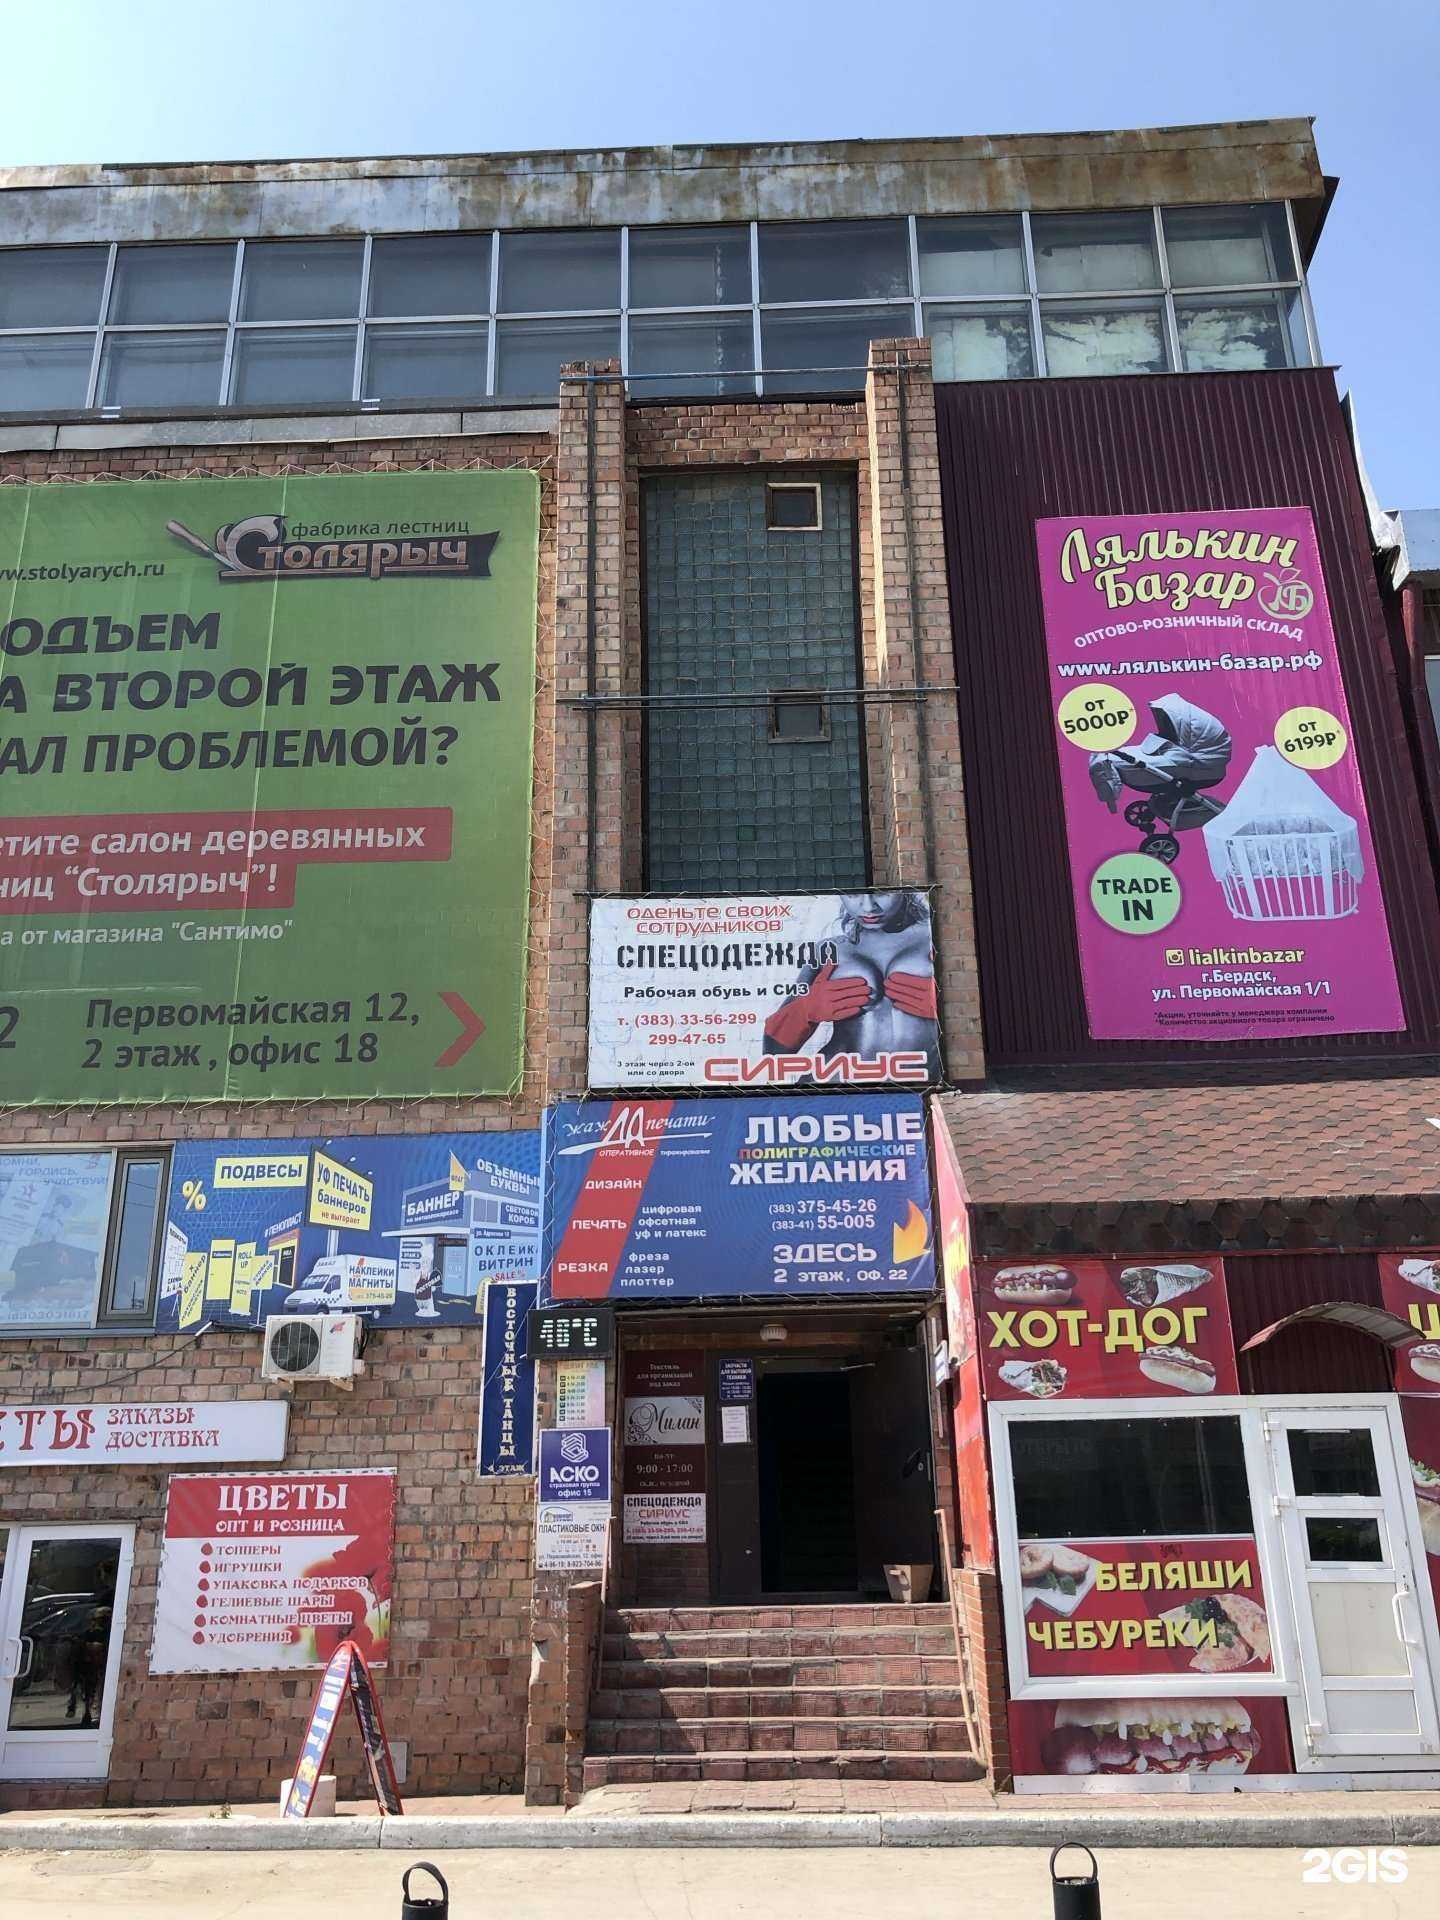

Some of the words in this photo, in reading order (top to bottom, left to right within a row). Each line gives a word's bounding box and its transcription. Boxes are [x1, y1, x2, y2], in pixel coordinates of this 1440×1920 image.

[291, 521, 380, 541] фабрика
[387, 520, 470, 538] лестниц
[215, 515, 468, 578] Столярыч
[1060, 528, 1298, 584] Лялькин
[1094, 566, 1255, 610] Базар
[1, 613, 220, 657] ОДЪЕМ
[1074, 614, 1243, 648] ОПТОВО-РОЗНИЧНЫЙ
[1246, 618, 1304, 642] СКЛАД
[1057, 650, 1323, 678] www.лялькин-базар.рф
[0, 675, 27, 713] А
[53, 663, 307, 713] ВТОРОЙ
[330, 662, 500, 705] ЭТАЖ
[0, 735, 67, 775] АЛ
[83, 716, 459, 773] ПРОБЛЕМОЙ?
[91, 831, 191, 854] салон
[201, 825, 425, 855] деревянных
[1097, 877, 1173, 895] TRADE
[627, 907, 720, 919] оденьте
[726, 905, 792, 917] своих
[1122, 899, 1155, 921] IN
[1, 931, 13, 945] а
[21, 929, 48, 945] от
[53, 926, 163, 944] магазина
[172, 919, 292, 943] "Сантимо"
[636, 920, 783, 937] сотрудников
[617, 941, 838, 971] СПЕЦОДЕЖДА
[1189, 947, 1304, 965] lialkinbazar
[1202, 969, 1277, 984] г.Бердск,
[624, 985, 696, 999] Рабочая
[702, 985, 751, 999] обувь
[757, 987, 767, 996] и
[773, 983, 809, 996] СИЗ
[1152, 989, 1176, 1001] ул.
[1180, 984, 1301, 1000] Первомайская
[1305, 982, 1331, 997] 1/1
[86, 996, 350, 1035] Первомайская
[364, 992, 420, 1025] 12,
[617, 1017, 629, 1026] т.
[634, 1013, 675, 1027] (383)
[680, 1013, 757, 1026] 33-56-299
[0, 1007, 20, 1049] 2
[649, 1034, 726, 1045] 299-47-65
[82, 1039, 100, 1069] 2
[229, 1034, 320, 1072] офис
[334, 1034, 378, 1062] 18
[704, 1053, 928, 1083] СИРИУС
[744, 1113, 922, 1144] ЛЮБЫЕ
[599, 1149, 654, 1157] ОПЕРАТИВНОЕ
[738, 1144, 916, 1160] ПОЛИГРАФИЧЕСКИЕ
[220, 1163, 302, 1181] ПОДВЕСЫ
[476, 1158, 540, 1187] ОБЪЕМНЫ
[730, 1159, 906, 1185] ЖЕЛАНИЯ
[317, 1162, 331, 1185] УФ
[333, 1172, 370, 1202] ПЕЧАТЬ
[490, 1176, 530, 1195] БУКВЫ
[585, 1177, 642, 1190] ДИЗАЙН
[182, 1181, 206, 1211] %
[318, 1189, 367, 1214] баннеров
[407, 1191, 460, 1216] БАННЕР
[642, 1204, 702, 1215] цифровая
[769, 1204, 795, 1214] (383)
[797, 1199, 877, 1213] 375-45-26
[321, 1211, 329, 1219] не
[331, 1213, 361, 1225] выгорает
[508, 1214, 535, 1225] КОРОБ
[572, 1218, 627, 1230] ПЕЧАТЬ
[638, 1216, 696, 1228] офсетная
[772, 1220, 814, 1231] (383-41)
[818, 1215, 876, 1229] 55-005
[635, 1229, 651, 1240] уф
[654, 1230, 662, 1238] и
[665, 1228, 707, 1238] латекс
[475, 1244, 539, 1256] ОКЛЕЙК
[628, 1251, 670, 1263] фреза
[773, 1243, 877, 1264] ЗДЕСЬ
[240, 1261, 249, 1269] UP
[479, 1257, 533, 1271] ВИТРИН
[558, 1262, 608, 1274] РЕЗКА
[625, 1263, 665, 1275] лазер
[349, 1277, 393, 1289] МАГНИТЫ
[495, 1271, 515, 1281] SALE
[620, 1276, 674, 1287] плоттер
[774, 1269, 787, 1283] 2
[888, 1269, 908, 1280] 22
[986, 1307, 1208, 1353] ХОТ-ДОГ
[501, 1287, 518, 1392] ВОСТОЧНЫЕ
[106, 1407, 196, 1425] ЗАКАЗЫ
[0, 1409, 95, 1450] ТЫ
[500, 1399, 516, 1456] ТАНЦЫ
[105, 1430, 219, 1452] ДОСТАВКА
[499, 1464, 525, 1473] ЭТАЖ
[550, 1465, 599, 1482] АСКО
[636, 1464, 658, 1473] 9:00
[667, 1463, 694, 1473] 17:00
[217, 1483, 348, 1516] ЦВЕТЫ
[558, 1489, 581, 1498] офис
[584, 1488, 592, 1496] 15
[627, 1497, 702, 1507] СПЕЦОДЕЖДА
[639, 1509, 690, 1518] СИРИУС
[216, 1520, 249, 1534] ОПТ
[253, 1520, 264, 1532] И
[269, 1518, 344, 1533] РОЗНИЦА
[539, 1524, 589, 1533] ПЛАСТИКОВЫЕ
[216, 1545, 281, 1556] ТОППЕРЫ
[214, 1562, 282, 1573] ИГРУШКИ
[1096, 1560, 1253, 1592] БЕЛЯШИ
[213, 1580, 288, 1590] УПАКОВКА
[293, 1578, 367, 1590] ПОДАРКОВ
[211, 1597, 283, 1607] ГЕЛИЕВЫЕ
[288, 1596, 334, 1607] ШАРЫ
[210, 1614, 298, 1625] КОМНАТНЫЕ
[301, 1612, 351, 1625] ЦВЕТЫ
[209, 1632, 291, 1643] УДОБРЕНИЯ
[1029, 1618, 1219, 1650] ЧЕБУРЕКИ
